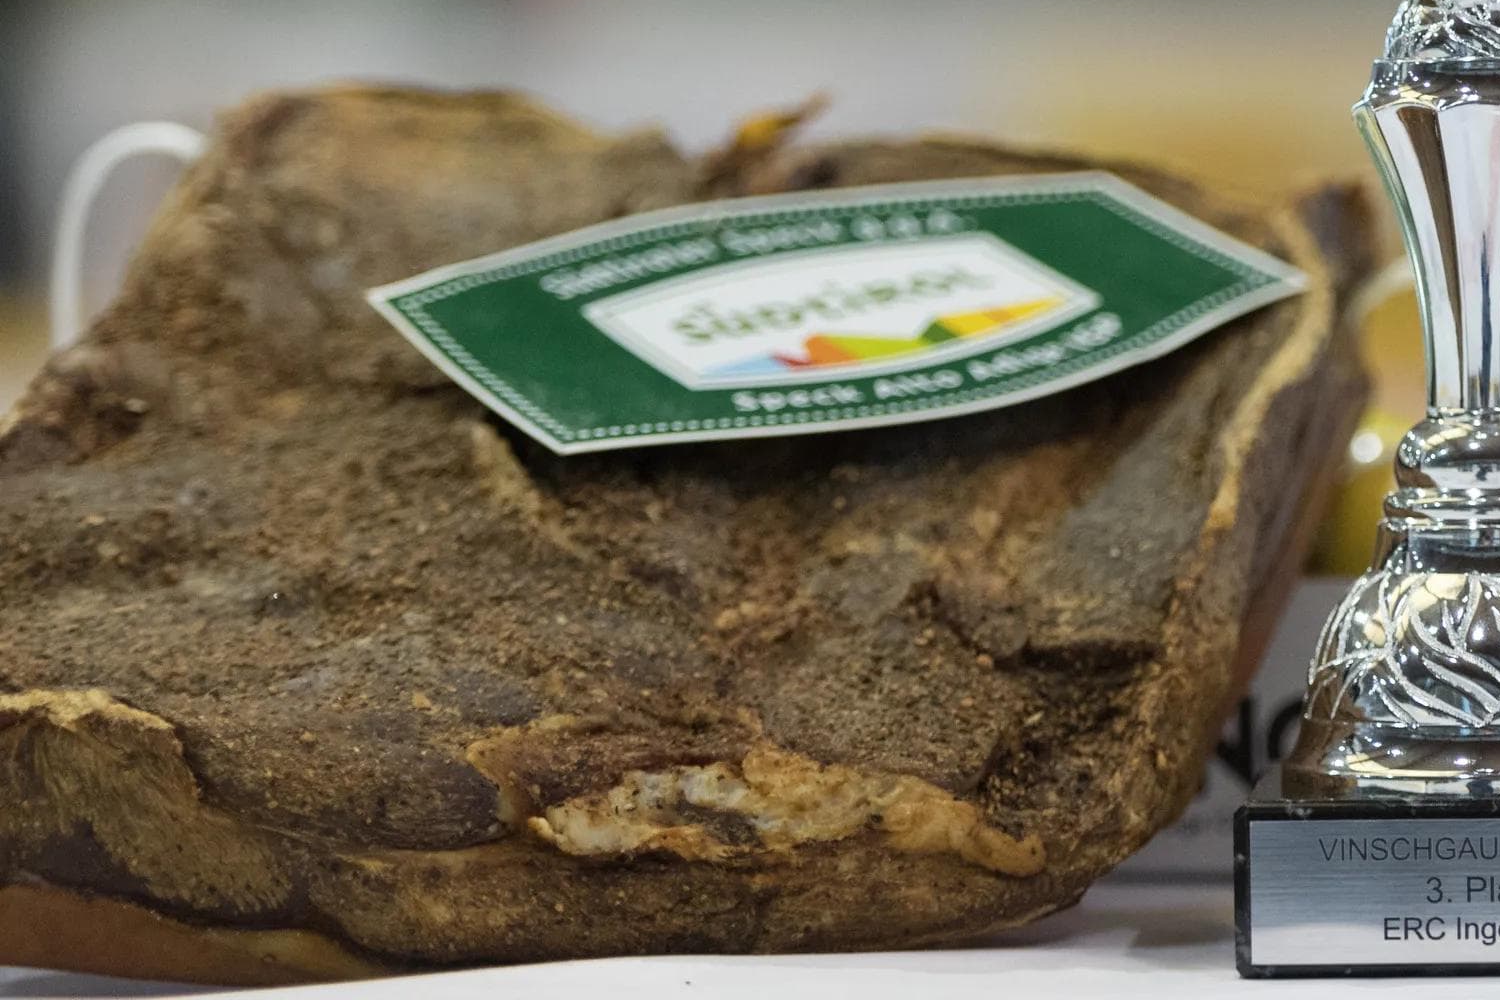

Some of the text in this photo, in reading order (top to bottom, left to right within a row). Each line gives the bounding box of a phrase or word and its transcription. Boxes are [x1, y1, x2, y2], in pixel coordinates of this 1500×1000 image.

[731, 384, 863, 412] Speck
[874, 368, 964, 400] Alto
[1318, 836, 1499, 862] VINSCHGAU
[1426, 876, 1452, 904] 3.
[1384, 916, 1446, 941] ERC
